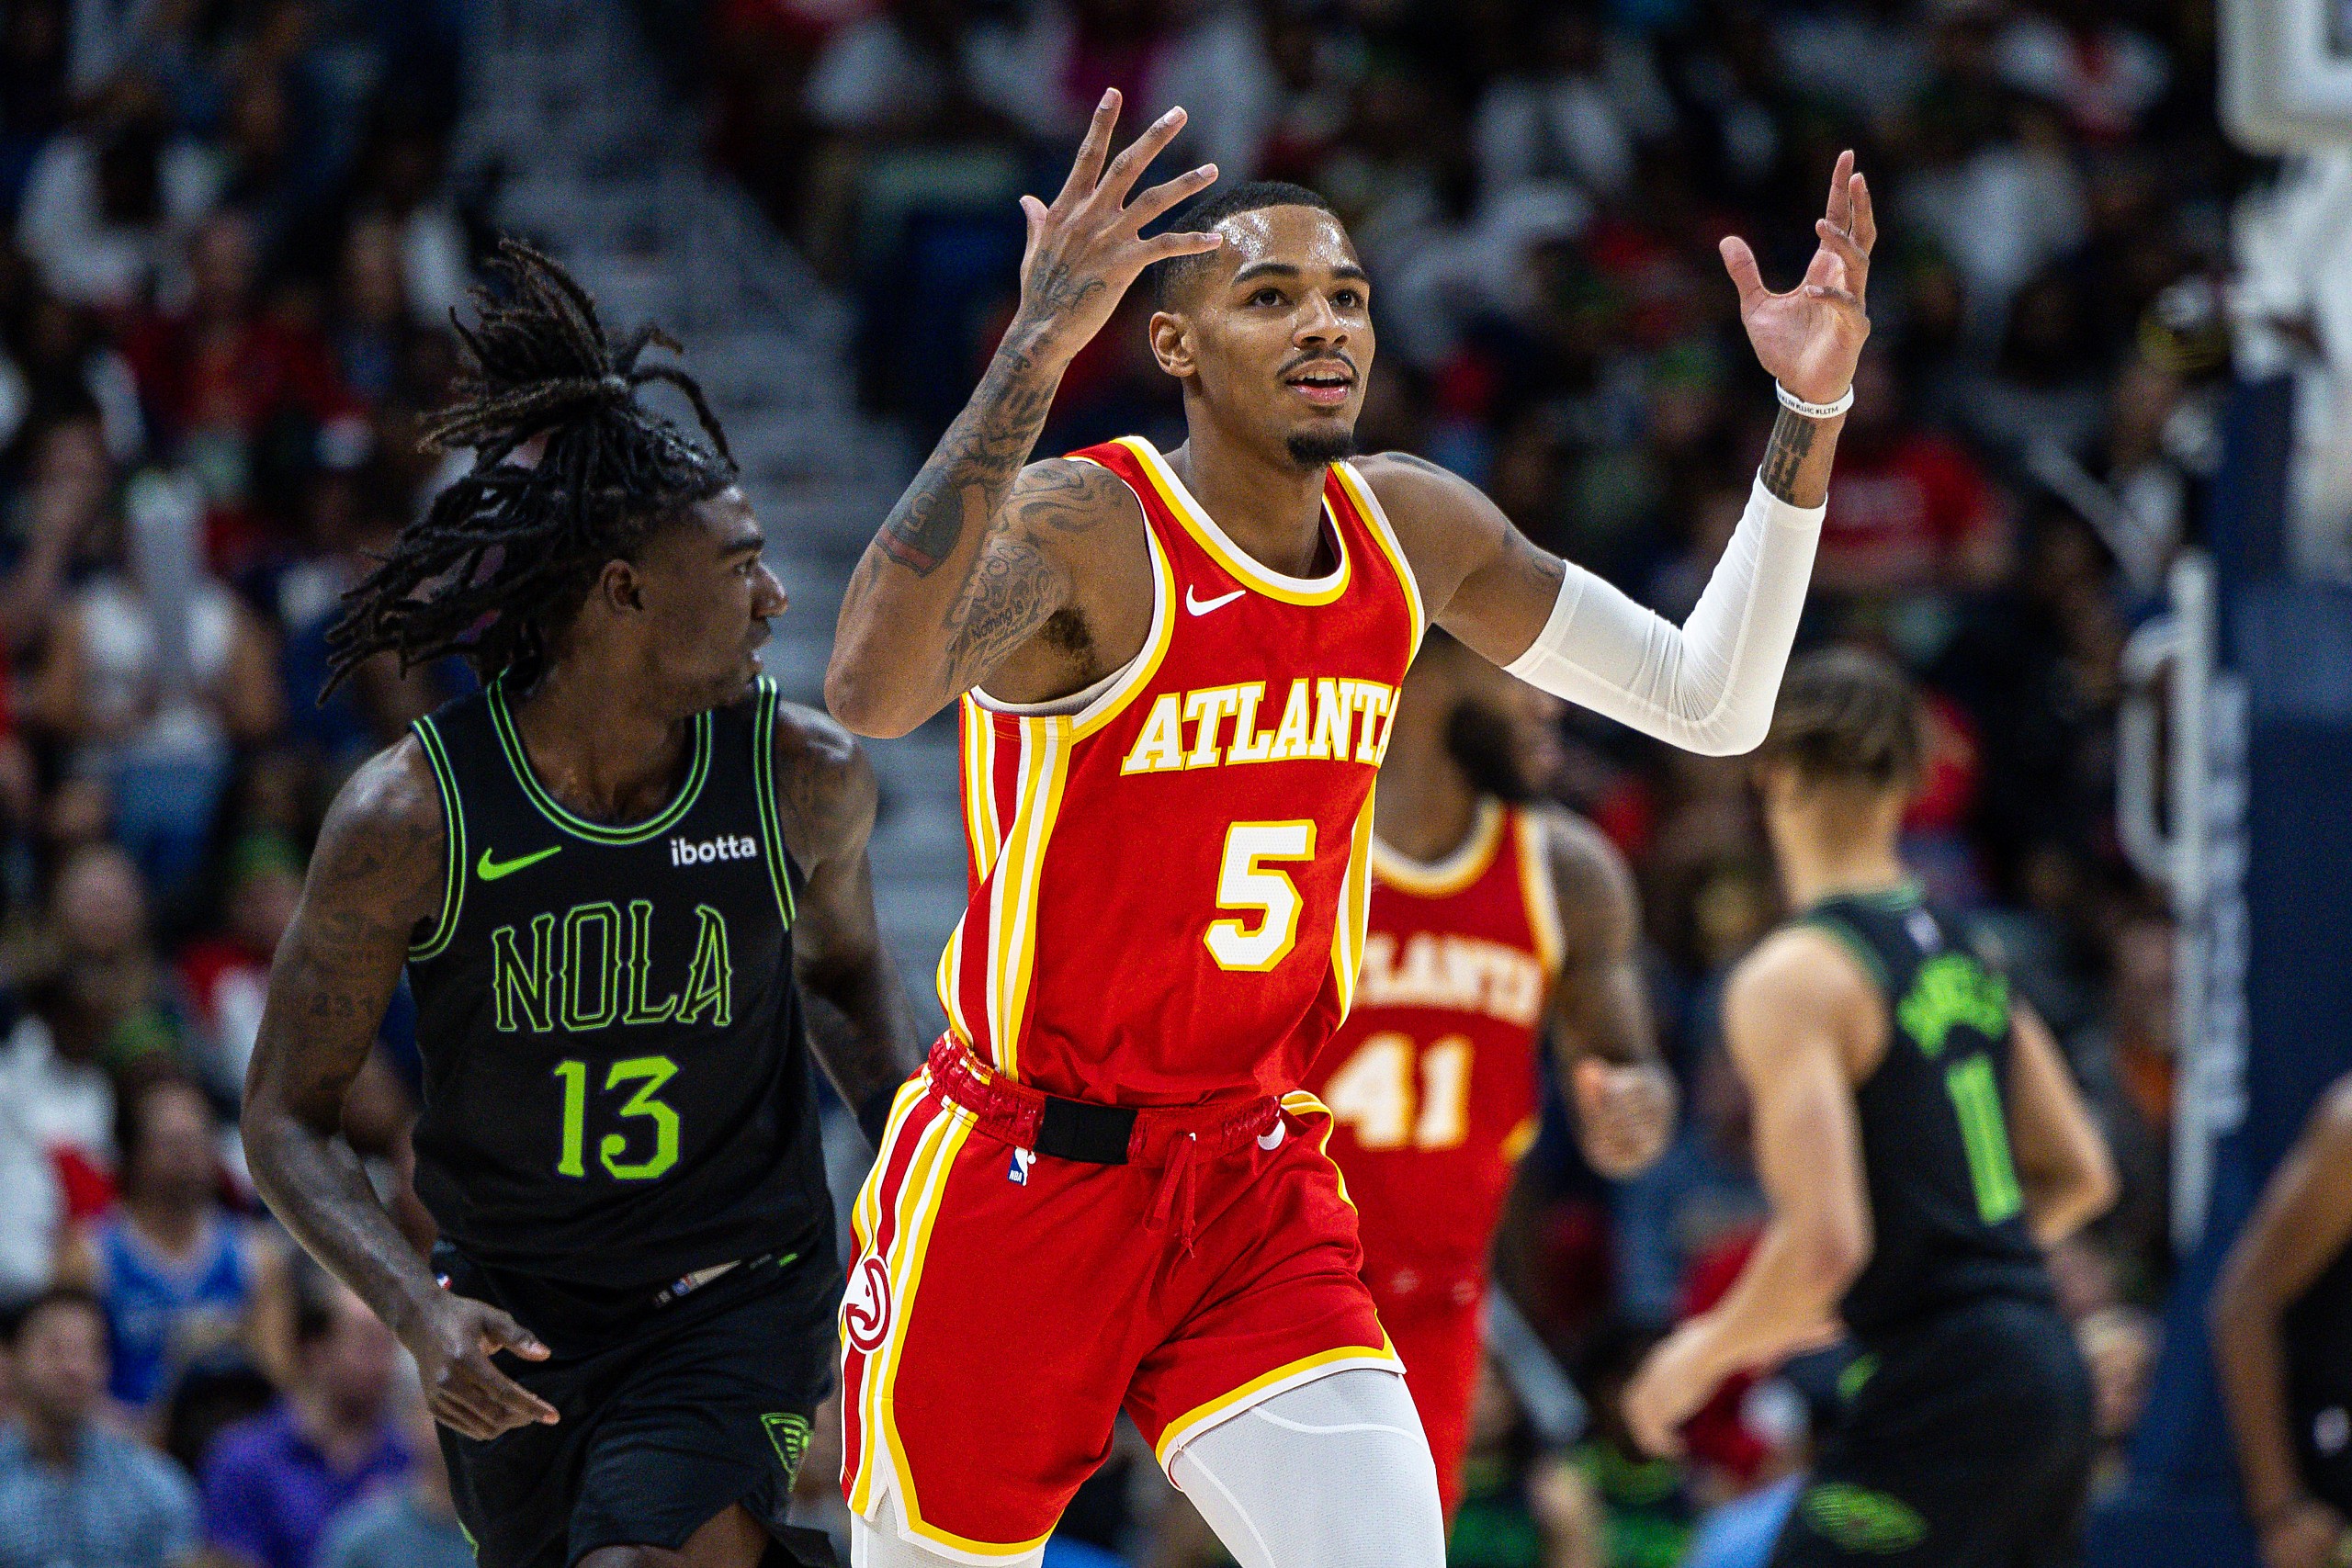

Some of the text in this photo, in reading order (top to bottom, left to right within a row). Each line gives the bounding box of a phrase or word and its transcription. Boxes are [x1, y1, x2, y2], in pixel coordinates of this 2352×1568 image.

[671, 835, 757, 866] ibotta
[1203, 818, 1317, 973] 5
[492, 900, 732, 1032] NOLA
[554, 1055, 680, 1180] 13
[1323, 1031, 1474, 1151] 41
[1945, 1054, 2023, 1225] 1
[1008, 1169, 1023, 1183] NBA
